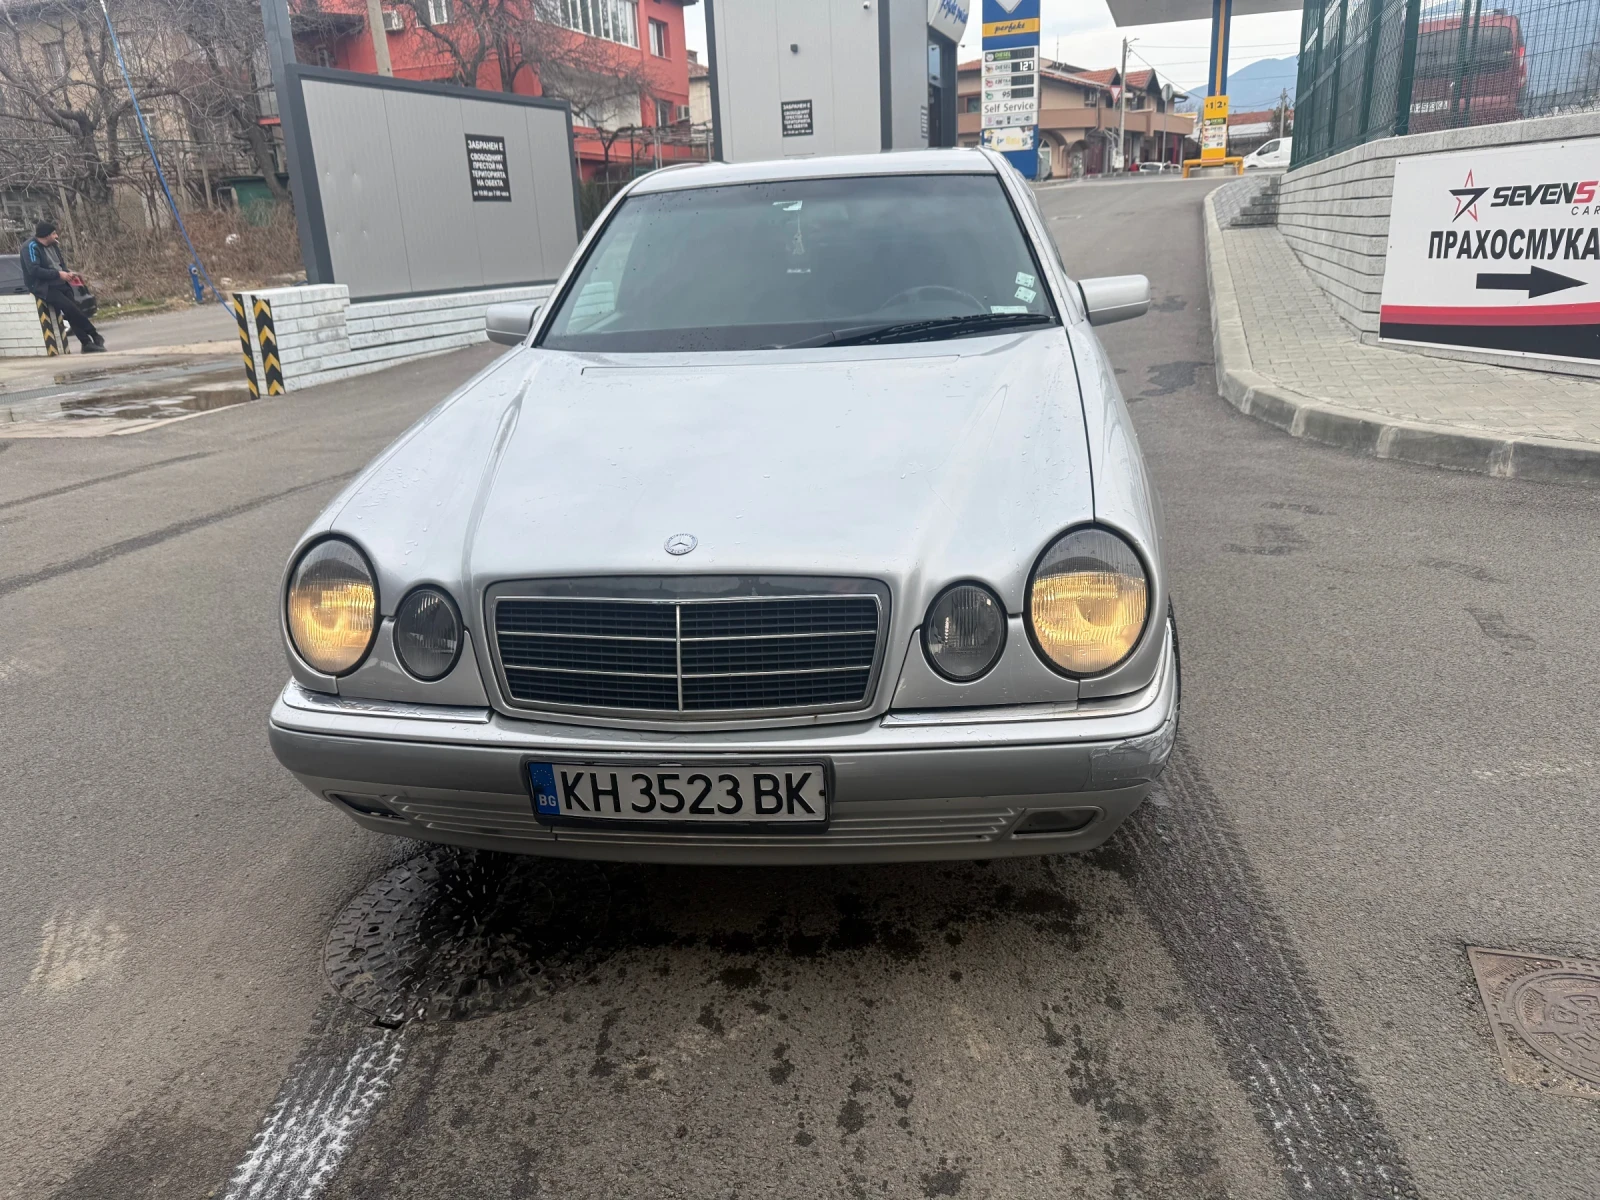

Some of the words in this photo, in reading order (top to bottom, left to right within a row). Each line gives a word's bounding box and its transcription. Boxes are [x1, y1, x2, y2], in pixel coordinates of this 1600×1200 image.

[1020, 61, 1034, 71] 127
[984, 104, 1000, 114] Self
[1003, 101, 1034, 112] Service
[1216, 101, 1223, 109] 2
[467, 140, 499, 151] ЗАБРАНЕН
[499, 142, 504, 151] Е
[472, 161, 496, 170] ПРЕСТОЙ
[496, 162, 504, 170] НА
[476, 179, 485, 187] НА
[485, 179, 504, 187] ОБЕКТА
[1490, 181, 1600, 207] SEVENS
[1571, 205, 1600, 216] CAR
[1428, 227, 1600, 260] ПРАХОСМУКА
[538, 793, 557, 807] BG
[560, 771, 621, 813] KH
[630, 773, 744, 815] 3523
[752, 771, 816, 815] BK
